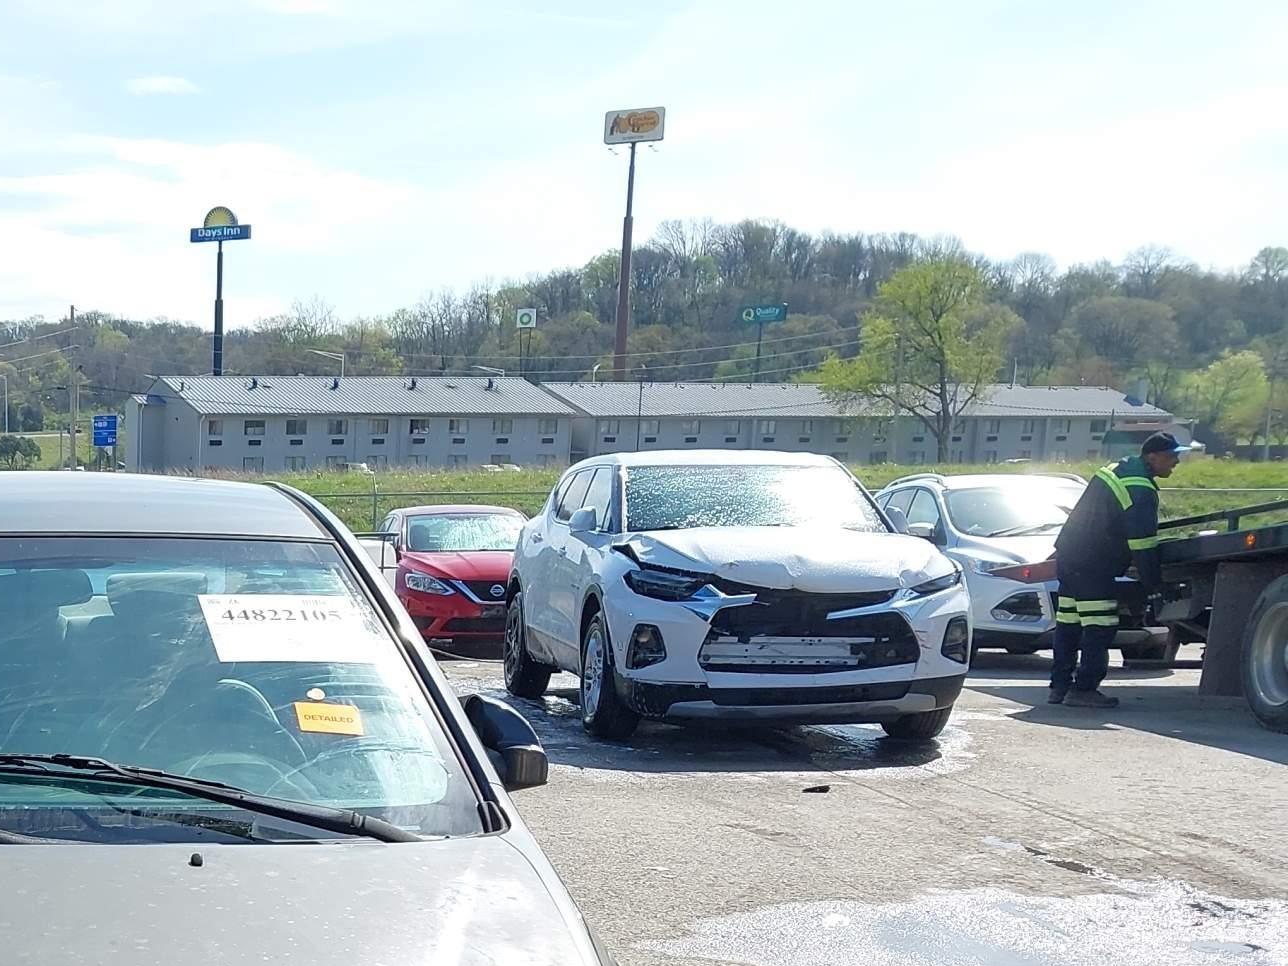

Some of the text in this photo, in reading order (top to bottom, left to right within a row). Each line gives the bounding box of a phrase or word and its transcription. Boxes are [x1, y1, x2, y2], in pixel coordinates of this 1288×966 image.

[197, 228, 222, 238] Days
[223, 226, 241, 236] Inn
[221, 608, 343, 622] 44822105
[303, 713, 355, 724] DETAILED
